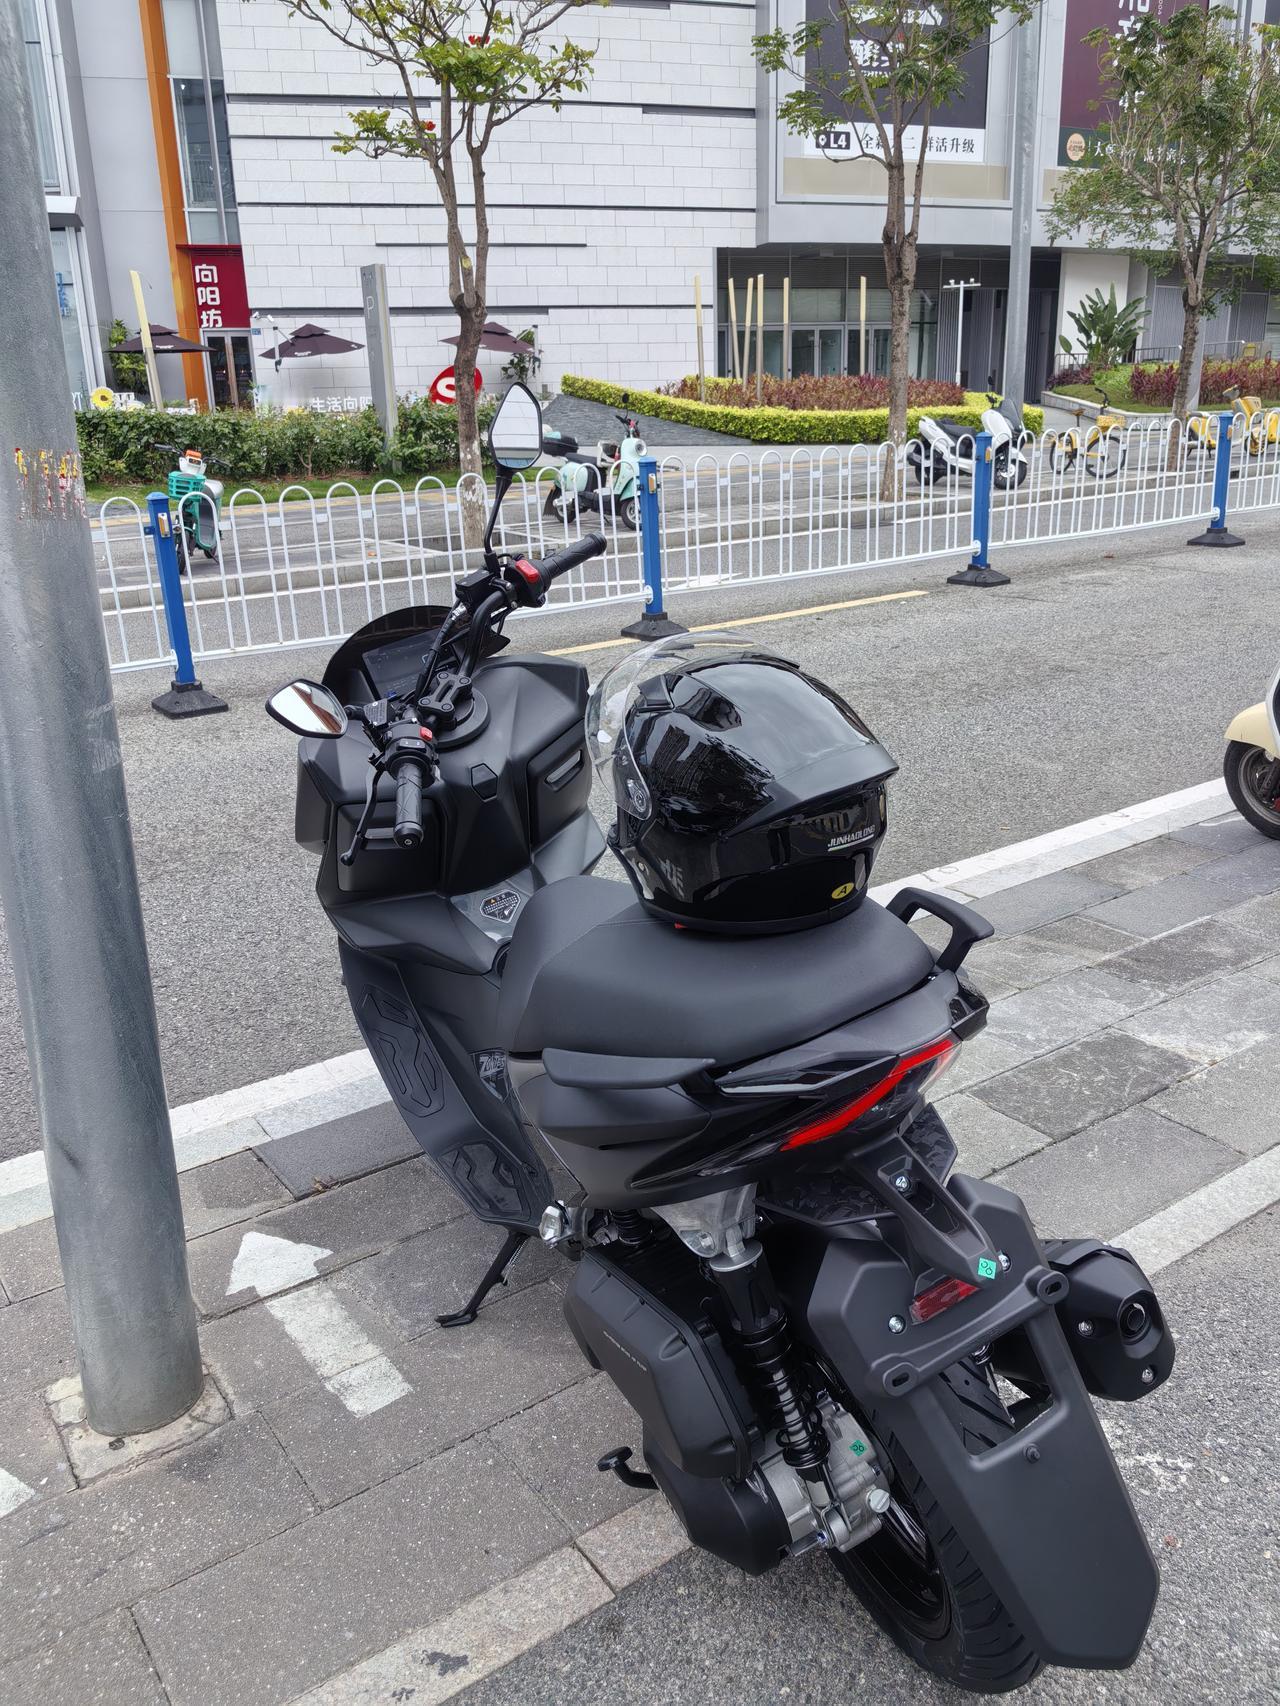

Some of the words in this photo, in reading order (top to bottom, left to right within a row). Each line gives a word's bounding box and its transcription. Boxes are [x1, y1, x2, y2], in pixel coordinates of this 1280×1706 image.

[830, 134, 847, 148] L4
[194, 263, 223, 328] 向阳坊
[366, 295, 375, 319] P
